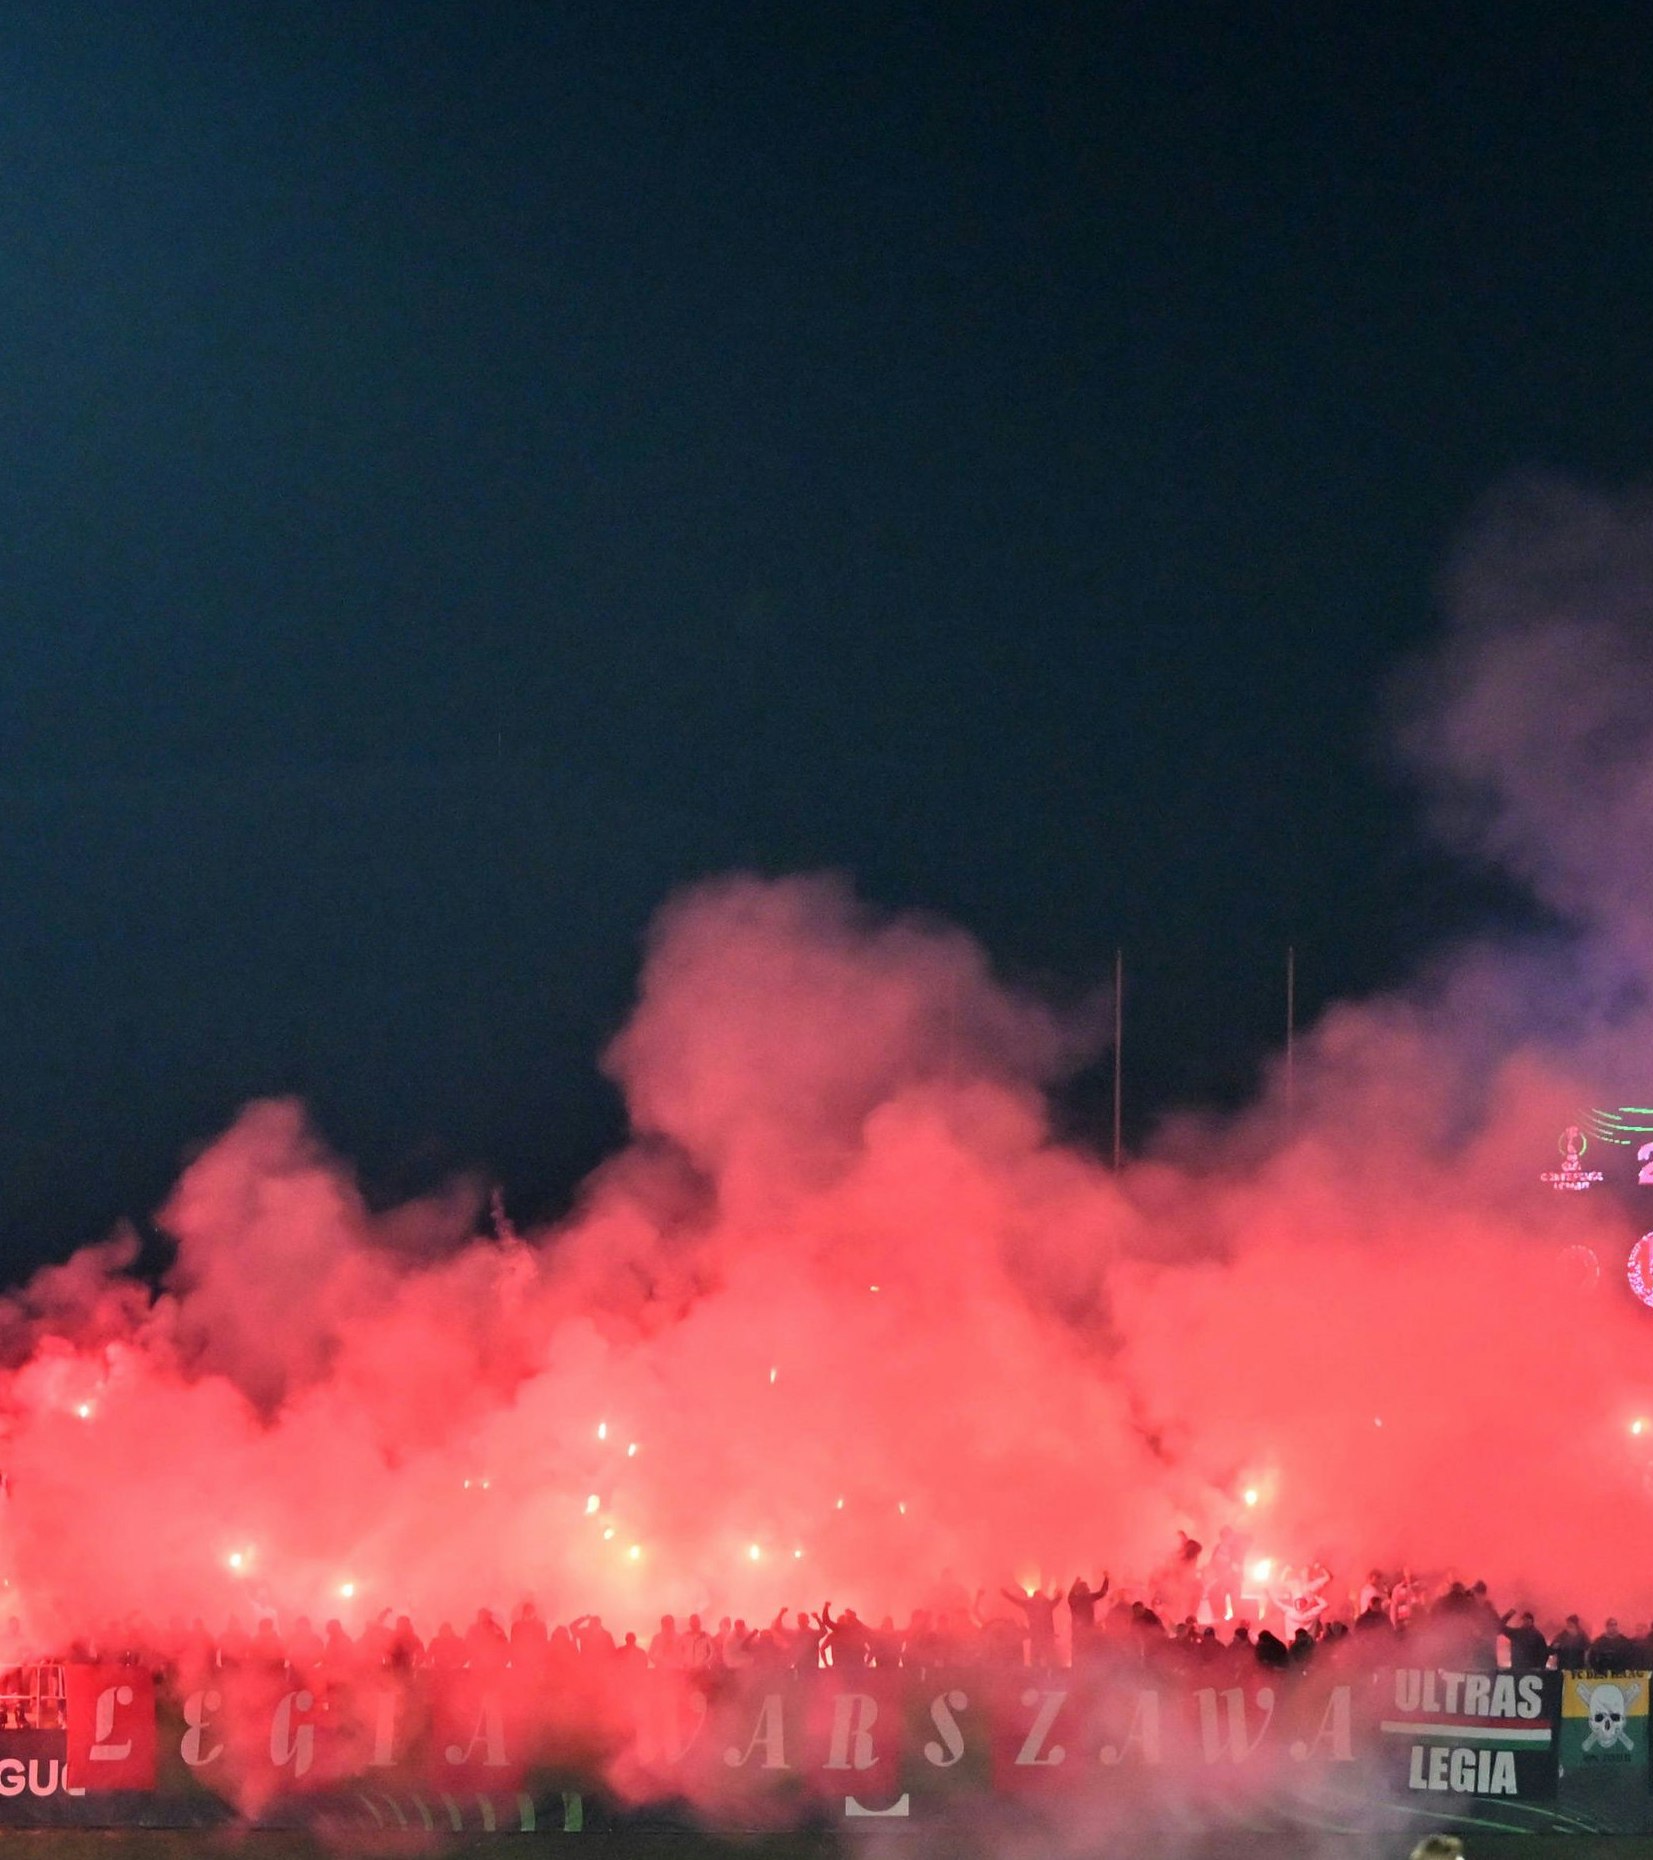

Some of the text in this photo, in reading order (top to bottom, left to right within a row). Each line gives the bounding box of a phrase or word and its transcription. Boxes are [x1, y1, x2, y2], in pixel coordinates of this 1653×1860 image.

[1394, 1669, 1544, 1719] ULTRAS
[89, 1685, 512, 1778] LEGIA
[1408, 1745, 1518, 1795] LEGIA
